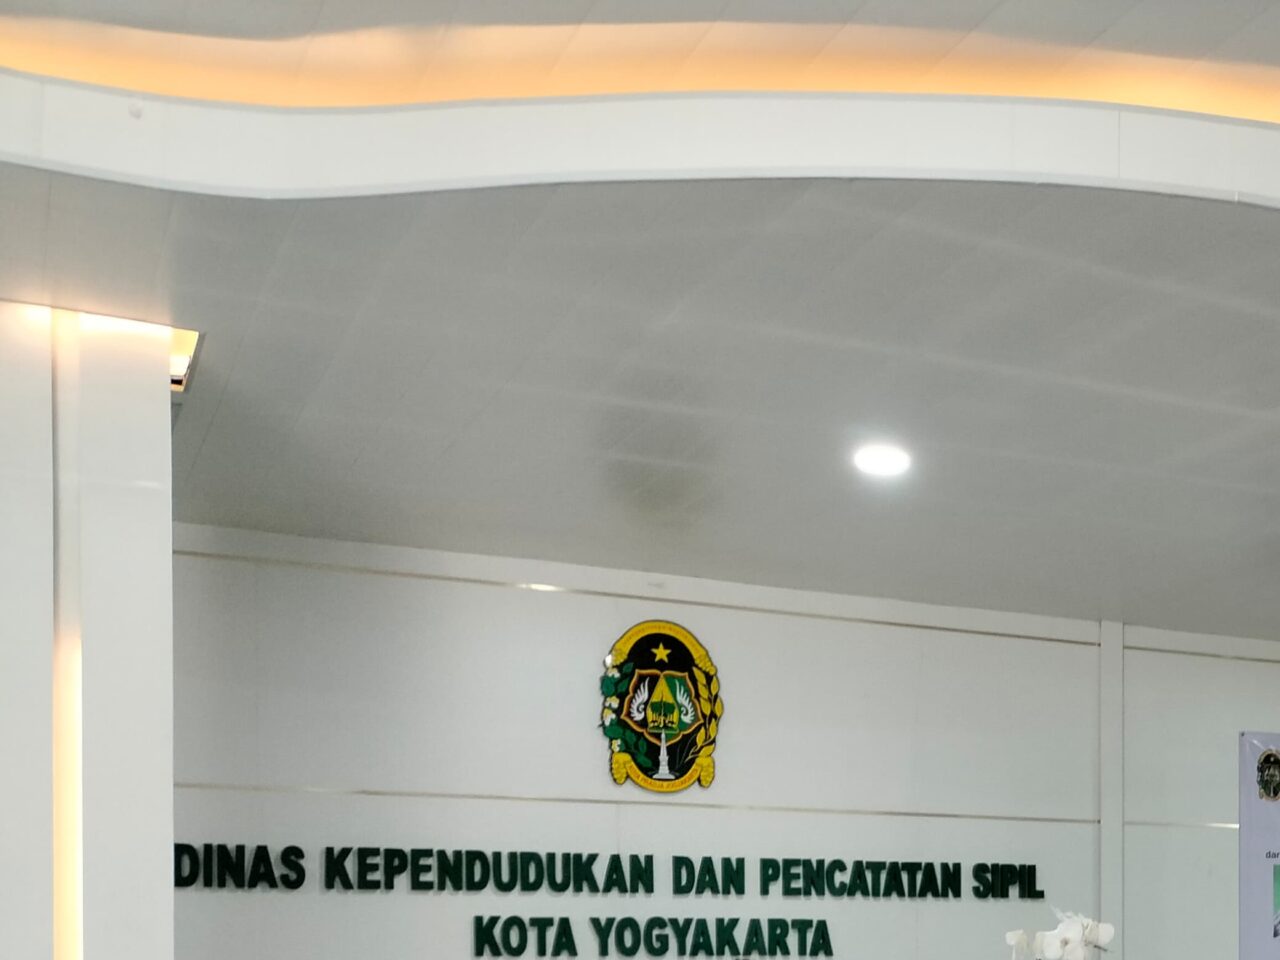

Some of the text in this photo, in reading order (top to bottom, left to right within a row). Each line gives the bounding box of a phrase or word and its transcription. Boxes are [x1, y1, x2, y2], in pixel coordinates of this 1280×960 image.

[174, 843, 1045, 899] DINAS KEPENDUDUKAN DAN PENCATATAN SIPIL
[473, 915, 834, 957] KOTA YOGYAKARTA
